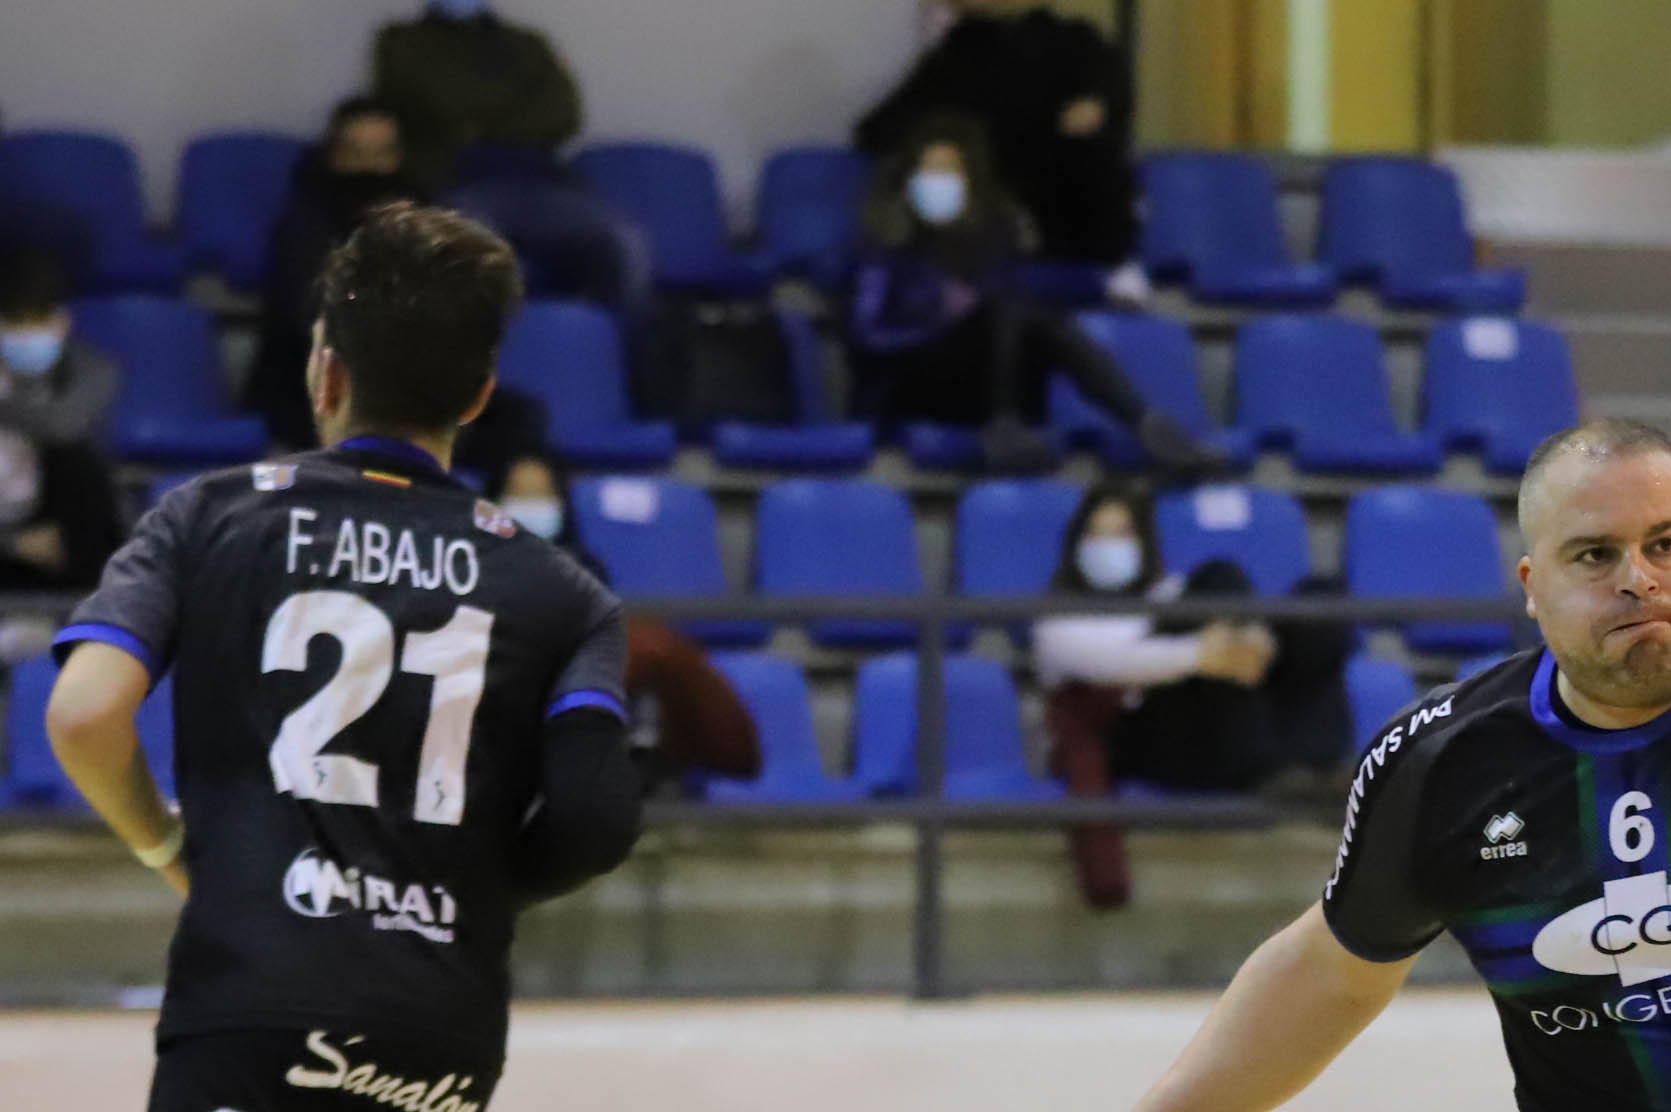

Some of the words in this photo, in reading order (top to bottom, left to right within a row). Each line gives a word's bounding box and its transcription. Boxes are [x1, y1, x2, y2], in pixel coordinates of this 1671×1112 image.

[286, 506, 320, 574] F.
[327, 518, 479, 596] ABAJO
[261, 589, 495, 826] 21
[1609, 790, 1655, 863] 6
